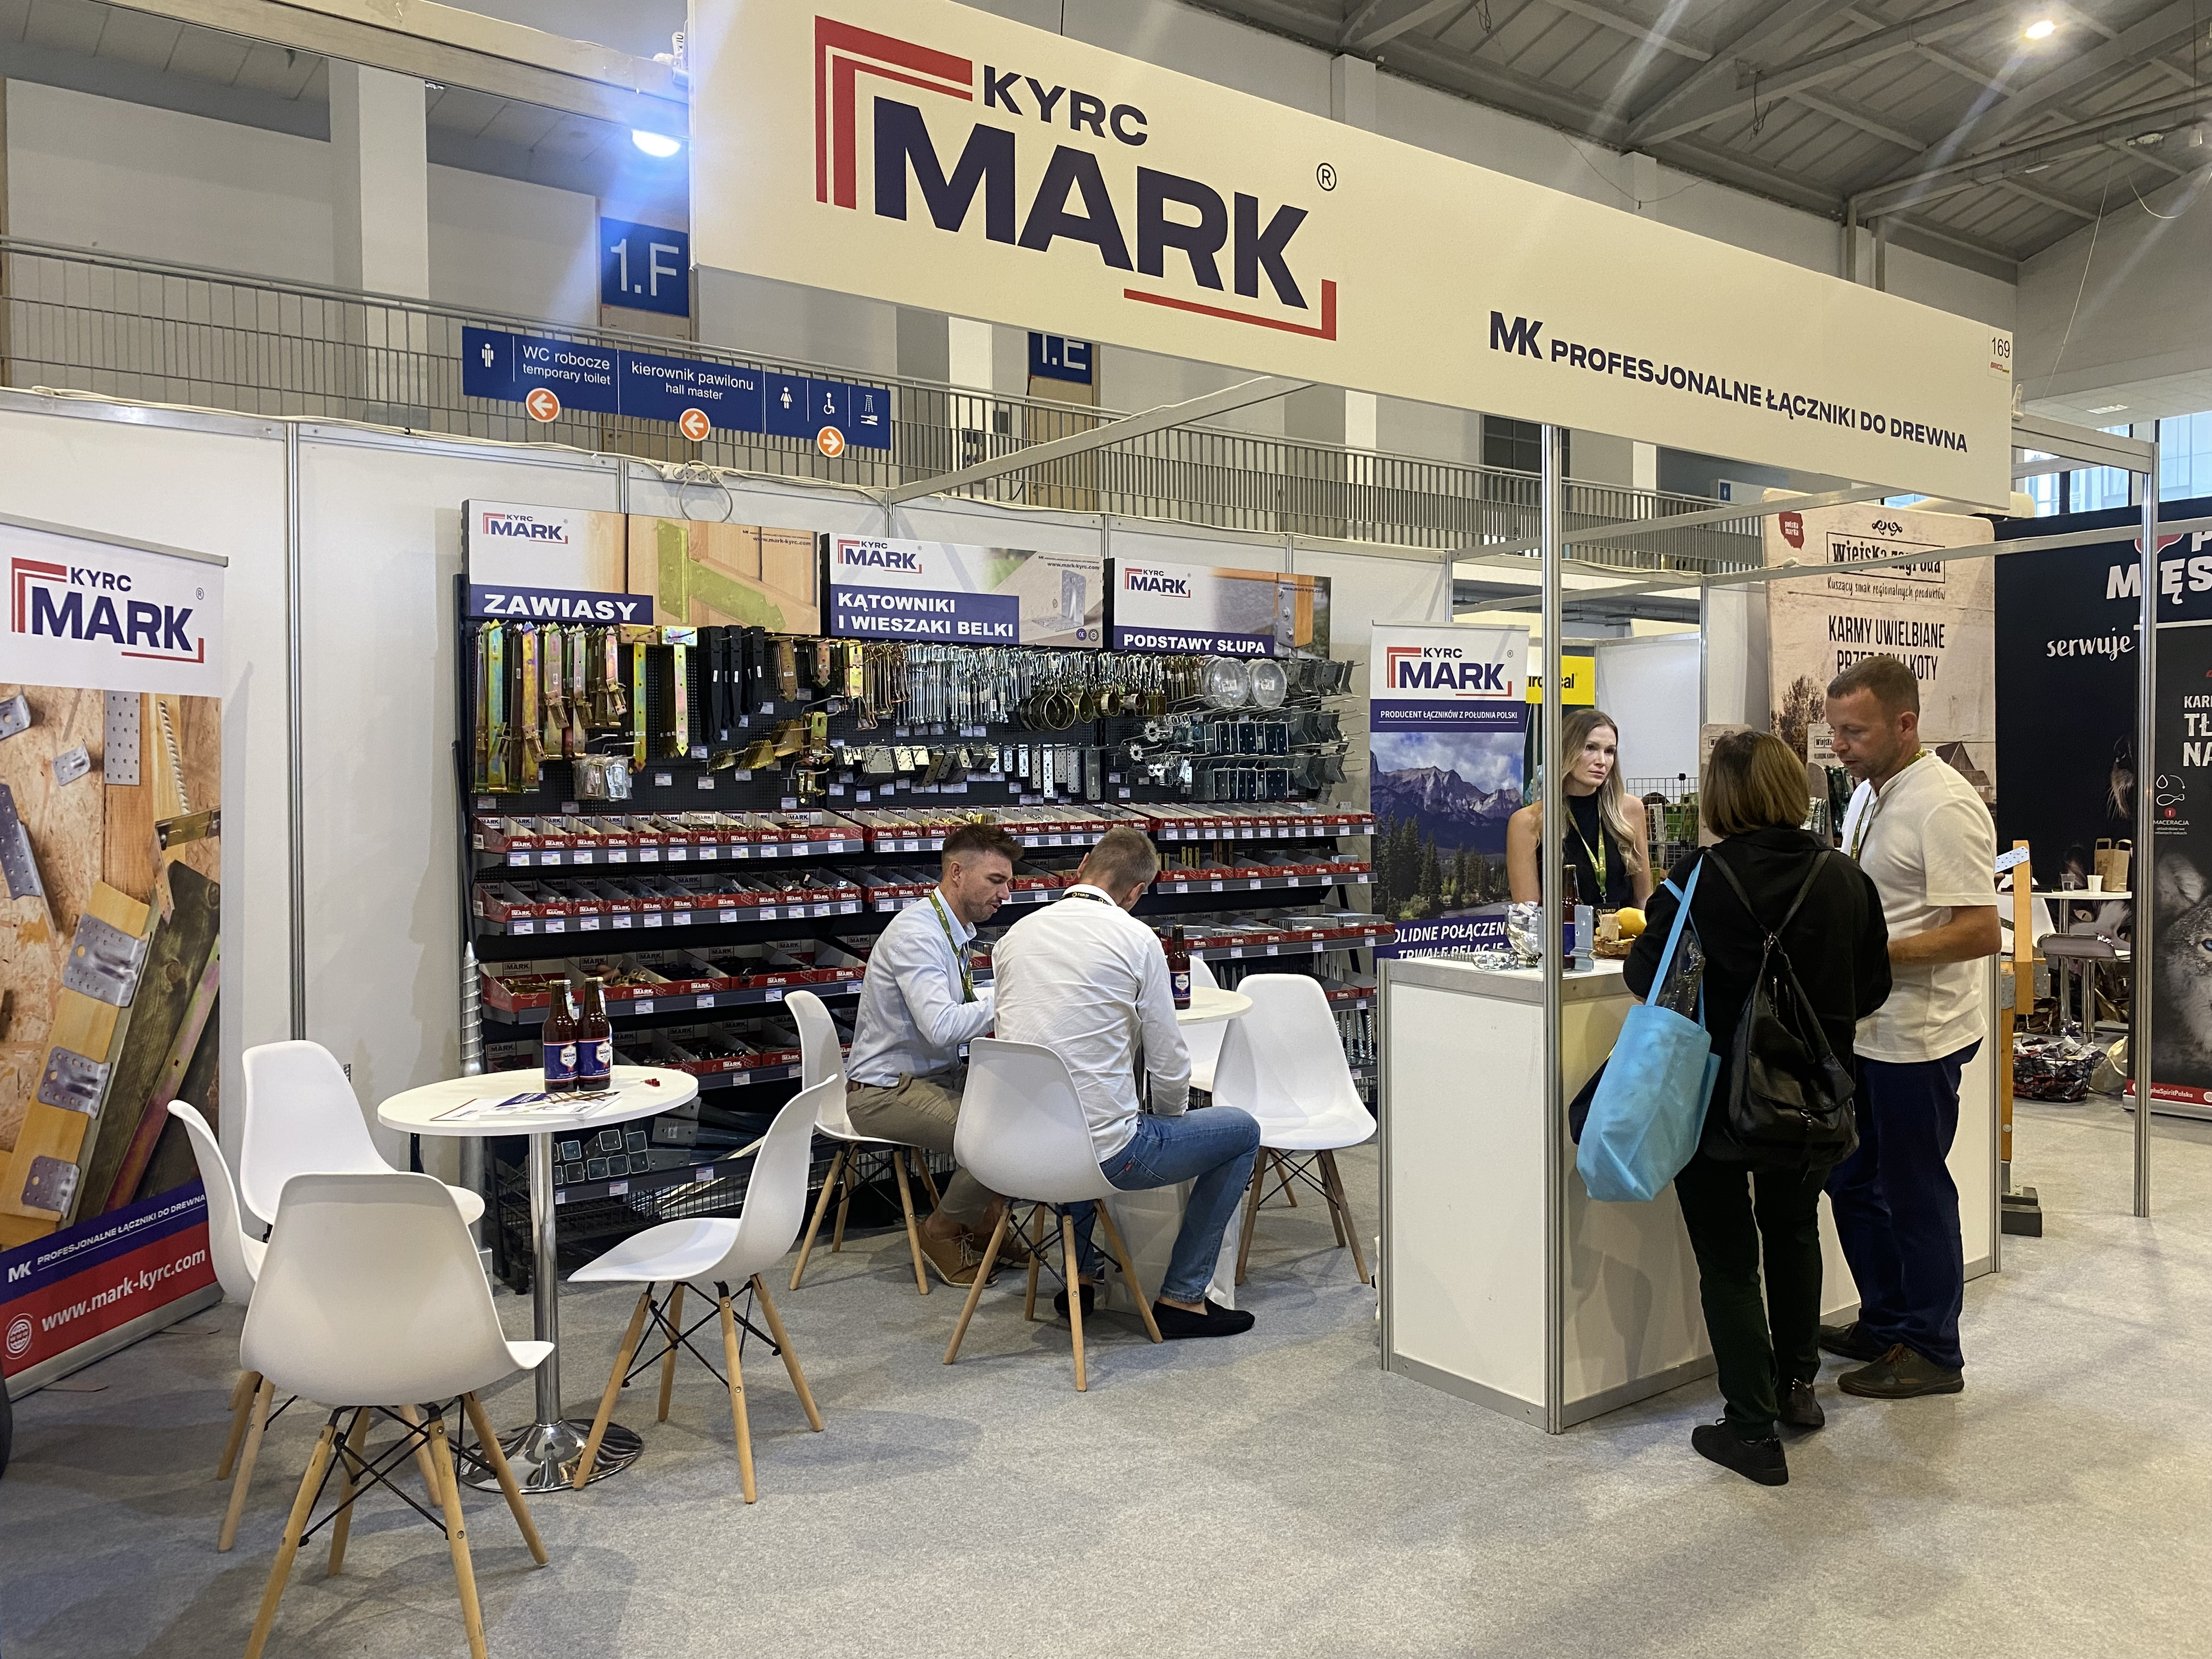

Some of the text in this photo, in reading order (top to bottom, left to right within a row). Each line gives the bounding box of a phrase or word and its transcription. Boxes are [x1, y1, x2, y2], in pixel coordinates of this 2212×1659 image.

[984, 65, 1148, 146] KYRC
[874, 96, 1308, 310] MARK
[611, 238, 679, 296] 1.F
[522, 345, 610, 370] WC robocze
[1992, 337, 2010, 358] 169
[522, 364, 611, 385] temporary toilet
[631, 362, 754, 391] kierownik pawilonu
[1490, 311, 1967, 453] MK PROFESJONALNE ŁĄCZNIKI DO DREWNA
[665, 382, 723, 400] hall master
[490, 520, 562, 540] MARK
[506, 514, 533, 522] KYRC
[846, 549, 916, 569] MARK
[71, 567, 132, 591] KYRC
[1131, 576, 1186, 594] MARK
[1827, 577, 1945, 601] Kuszący smak regionalnych produktów
[2106, 556, 2212, 604] MĘS
[483, 594, 637, 620] ZAWIASY
[838, 593, 955, 613] KĄTOWNIKI
[32, 586, 193, 651] MARK
[838, 615, 1013, 637] I WIESZAKI BELKI
[1124, 634, 1266, 653] PODSTAWY SŁUPA
[1829, 615, 1945, 648] KARMY UWIELBIANE
[1424, 648, 1463, 658] KYRC
[2047, 627, 2135, 661] serwuje
[1400, 661, 1504, 690] MARK
[1837, 650, 1874, 674] PRZ
[1910, 654, 1938, 680] KOTY
[2184, 696, 2212, 708] KAR
[1380, 710, 1422, 719] PRODUCENT
[1423, 709, 1458, 720] ŁĄCZNIKÓW
[1465, 711, 1496, 719] POŁUDNIA
[2184, 713, 2212, 736] TŁ
[1395, 922, 1506, 943] OLIDNE POŁĄCZEN
[2151, 1088, 2193, 1098] phaSpiritPolska
[8, 1194, 205, 1283] MK PROFESJONALNE ŁĄCZNIKI DO DREWNA
[42, 1249, 205, 1332] www.mark-kyrc.com
